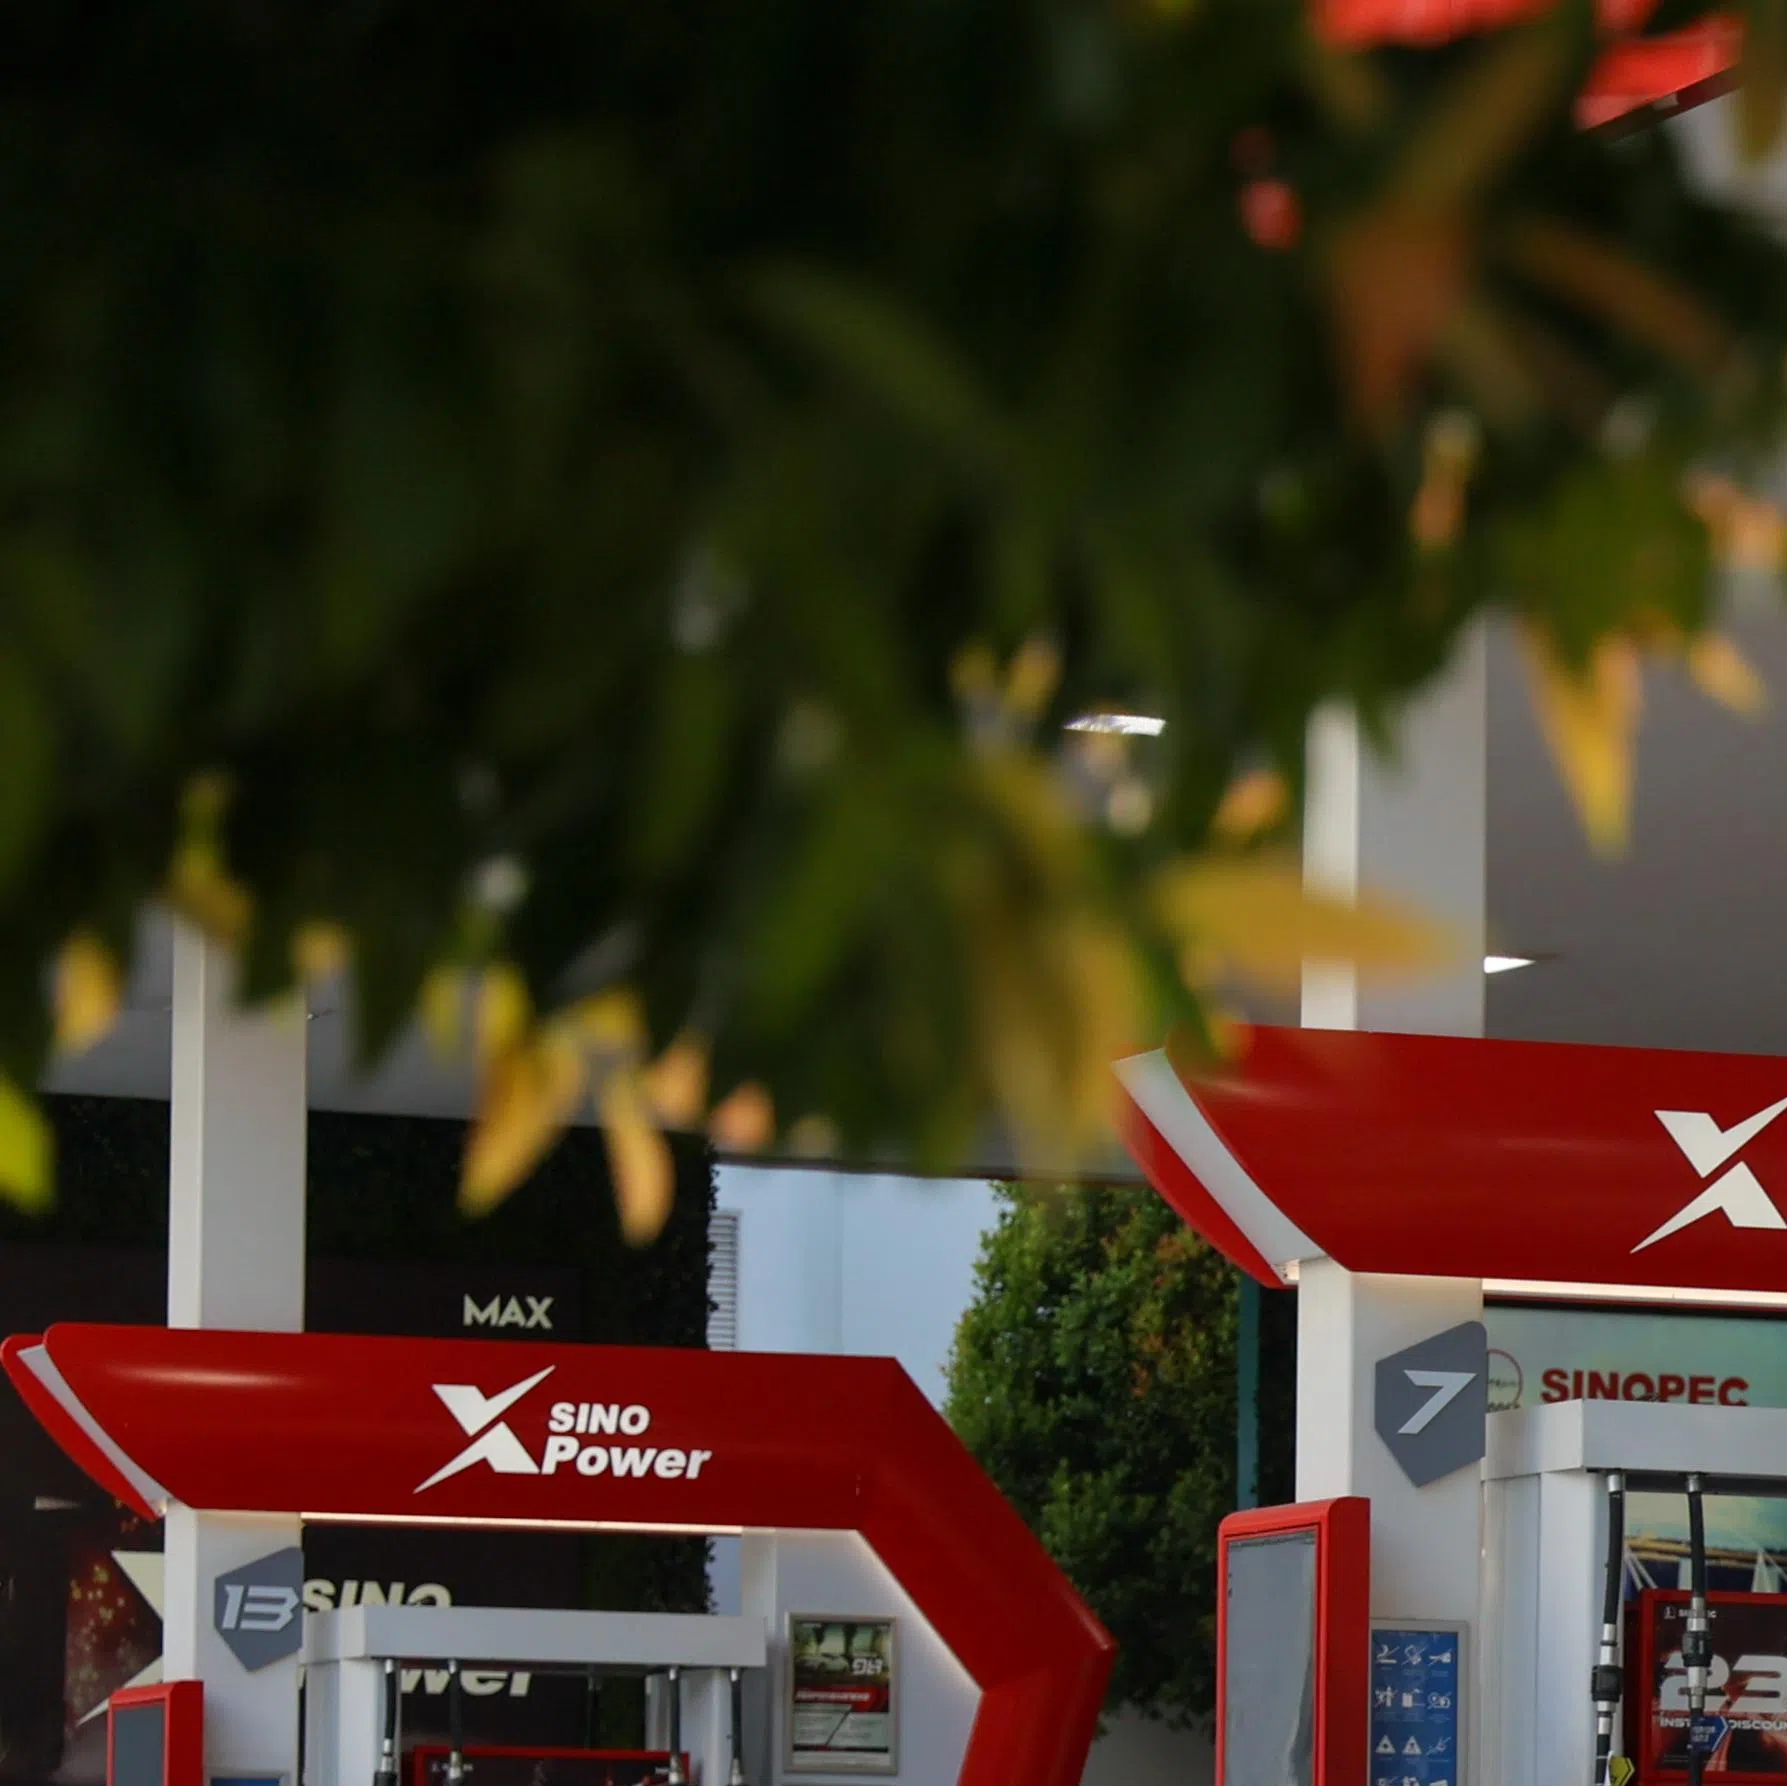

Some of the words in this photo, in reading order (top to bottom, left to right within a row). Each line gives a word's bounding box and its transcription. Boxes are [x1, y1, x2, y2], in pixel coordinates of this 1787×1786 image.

[464, 1294, 554, 1329] MAX
[1397, 1369, 1478, 1435] 7
[1541, 1368, 1750, 1407] SINOPEC
[548, 1402, 649, 1436] SINO
[541, 1436, 712, 1480] Power
[222, 1585, 298, 1631] 13
